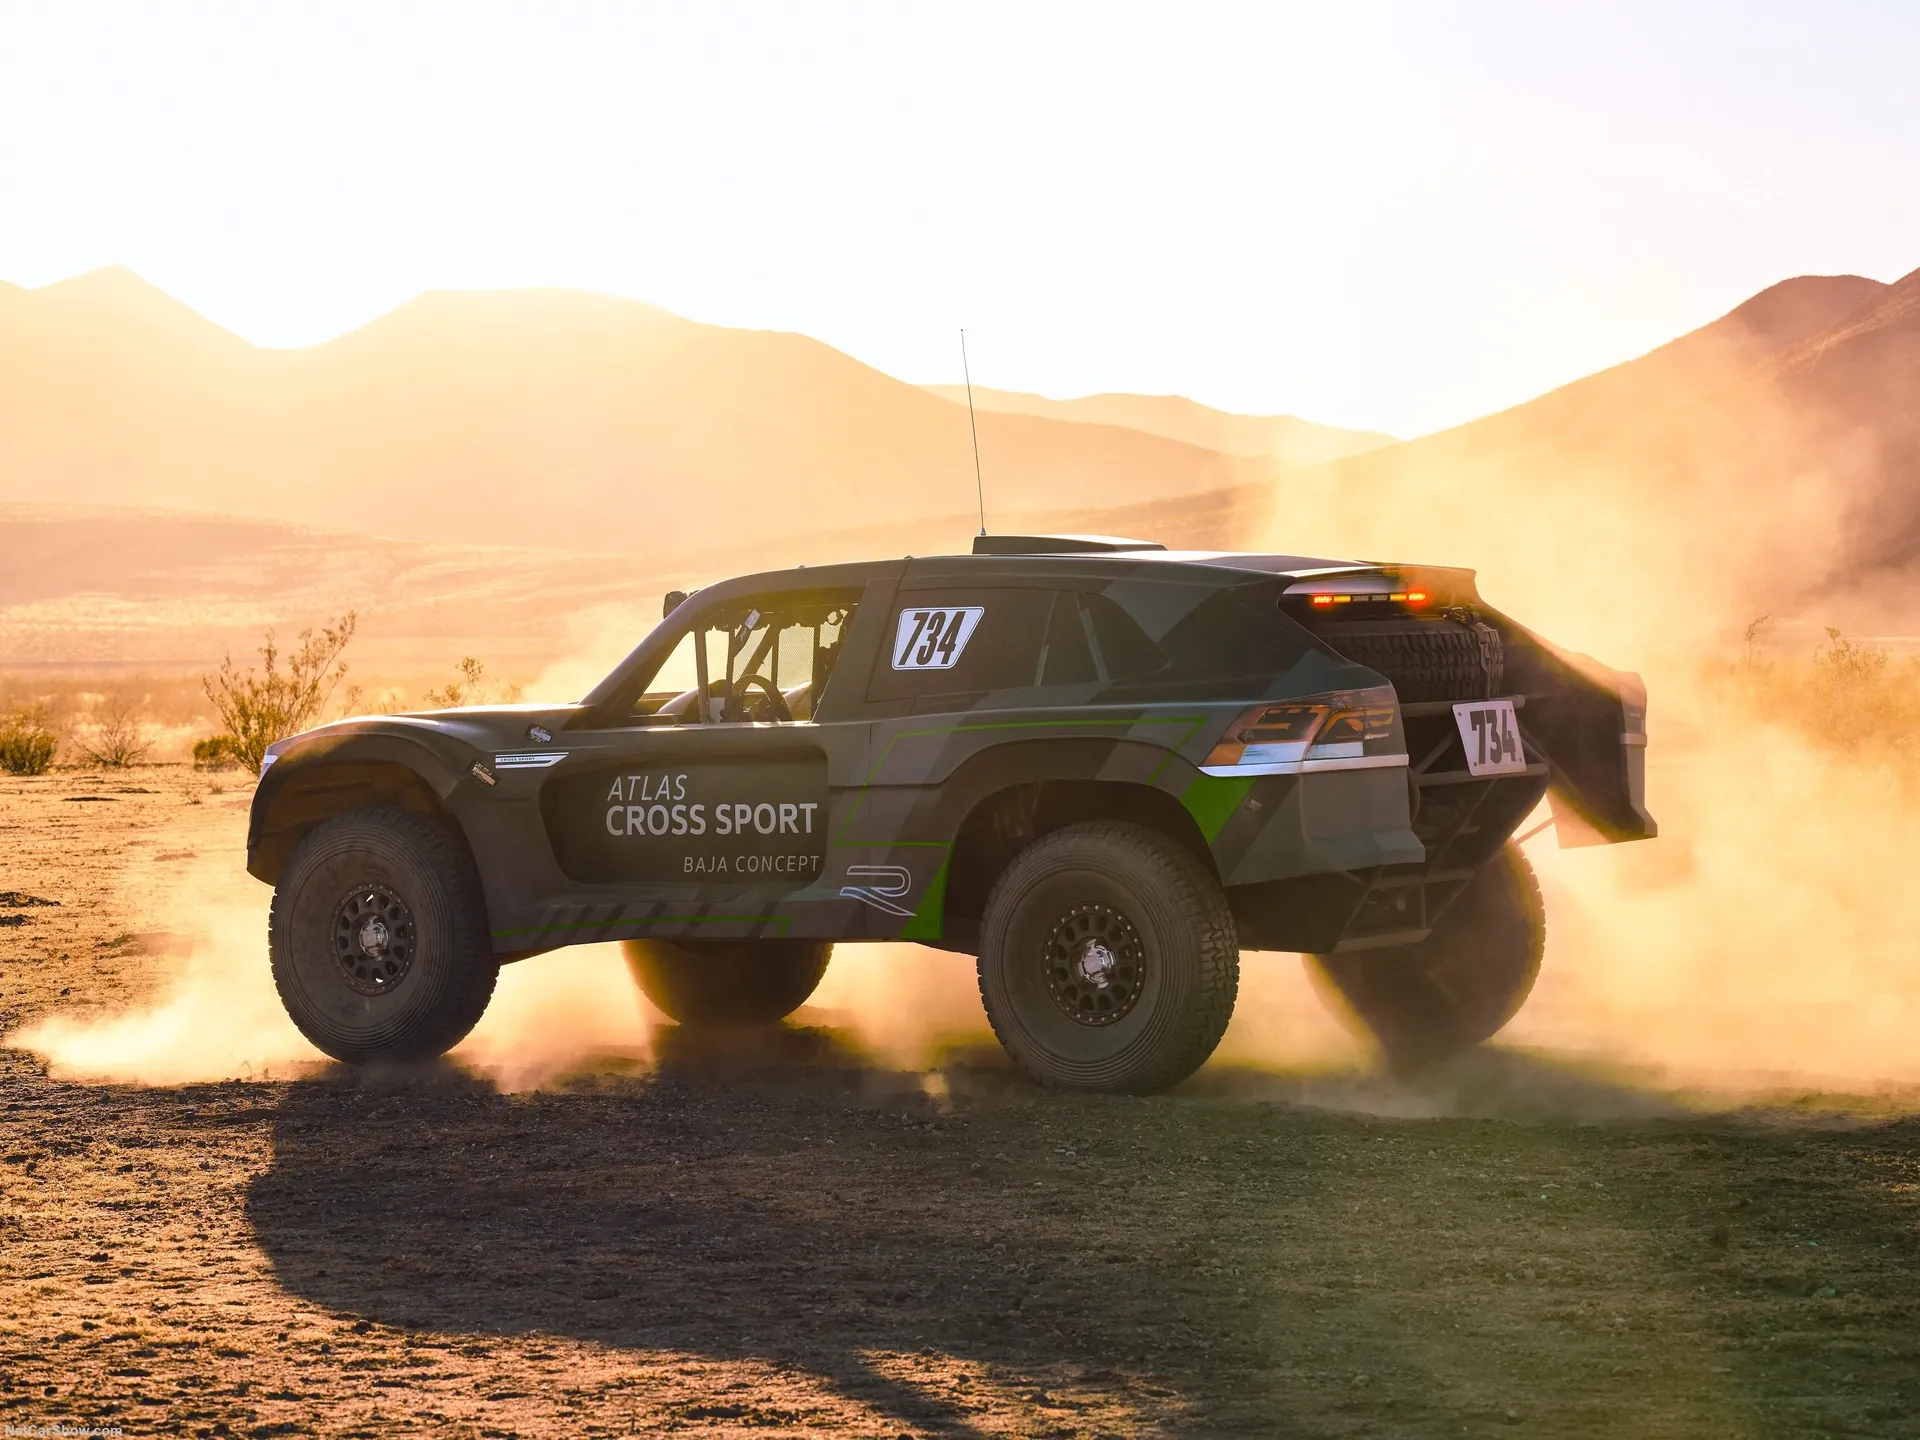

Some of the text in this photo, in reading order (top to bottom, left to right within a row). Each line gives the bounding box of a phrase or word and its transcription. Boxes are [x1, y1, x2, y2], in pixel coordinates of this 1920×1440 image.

[898, 611, 967, 665] 734
[1469, 709, 1516, 765] 734
[606, 774, 688, 802] ATLAS
[605, 802, 818, 836] CROSS SPORT
[683, 855, 820, 873] BAJA CONCEPT
